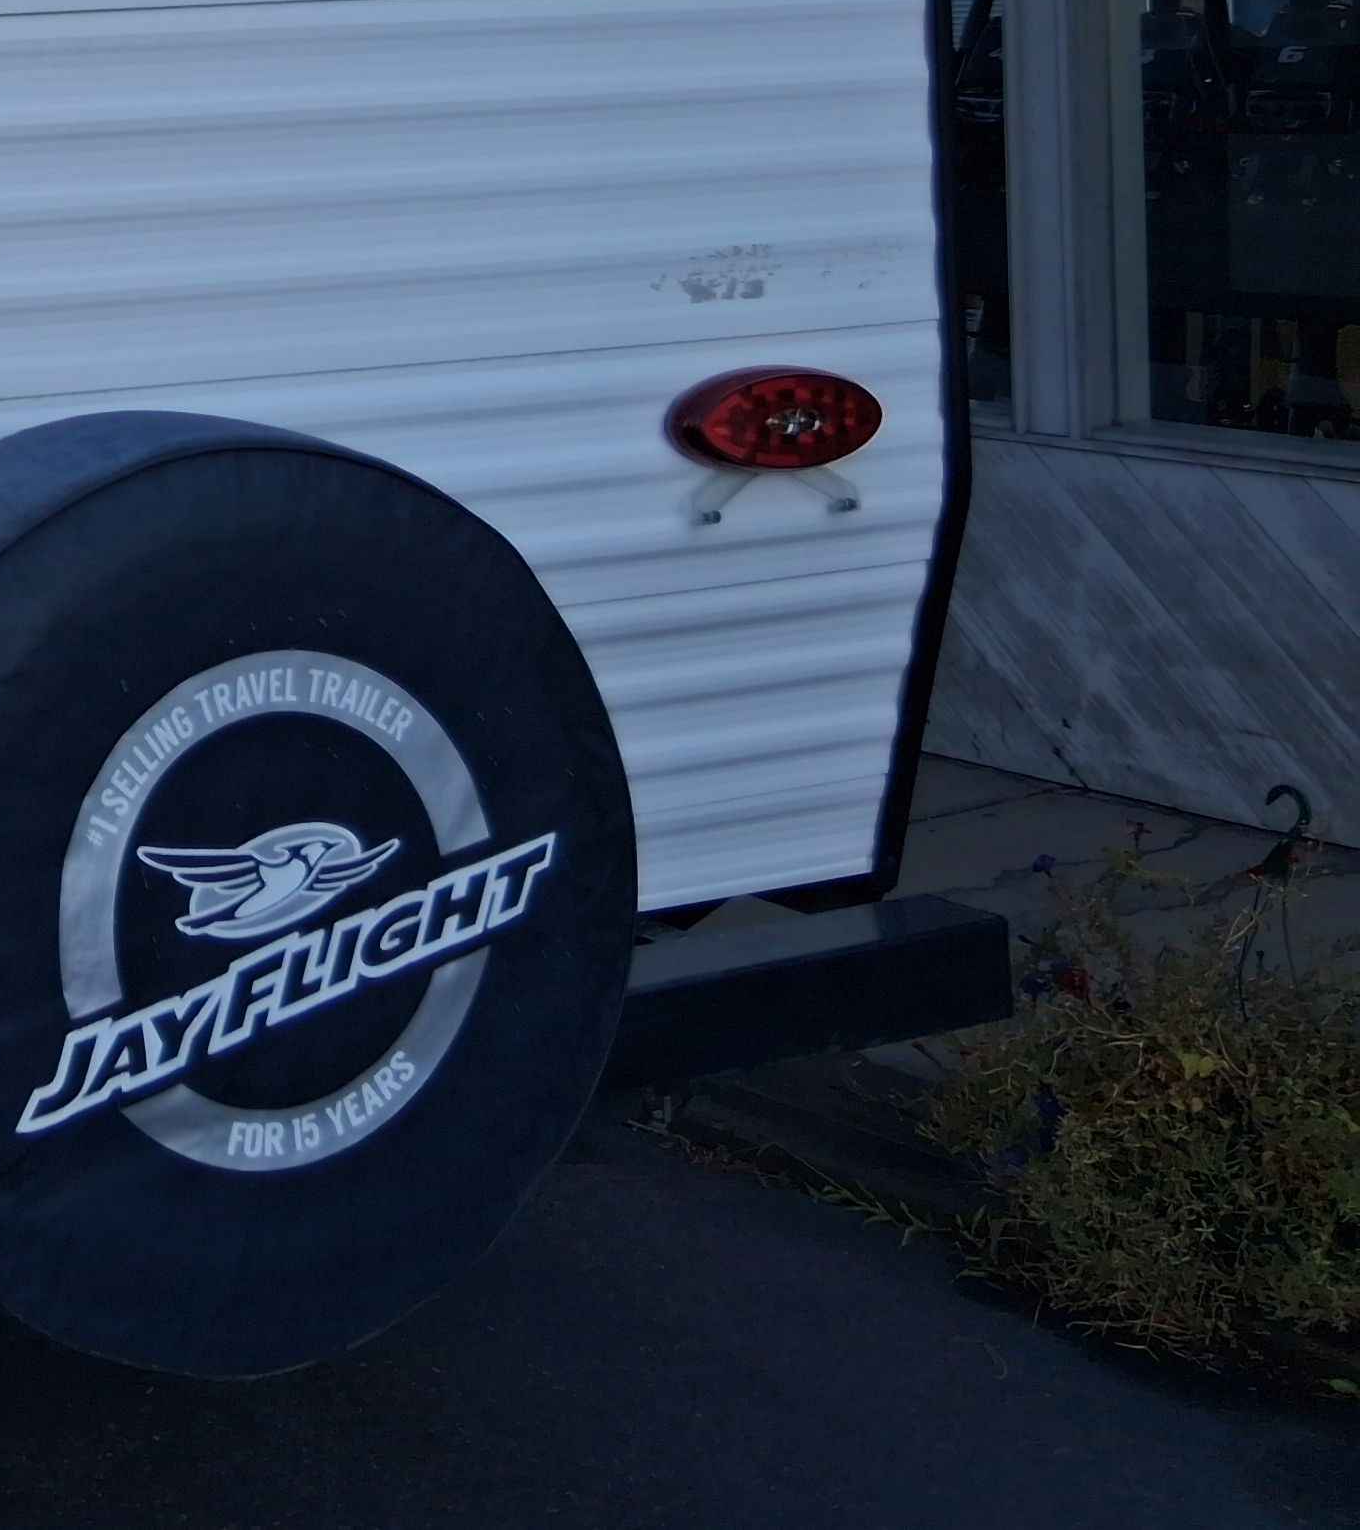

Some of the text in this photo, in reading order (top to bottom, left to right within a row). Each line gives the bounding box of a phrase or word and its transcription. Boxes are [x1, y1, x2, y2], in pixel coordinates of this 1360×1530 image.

[87, 668, 414, 847] #1 SELLING TRAVEL TRAILER
[227, 1050, 415, 1157] FOR 15 YEARS
